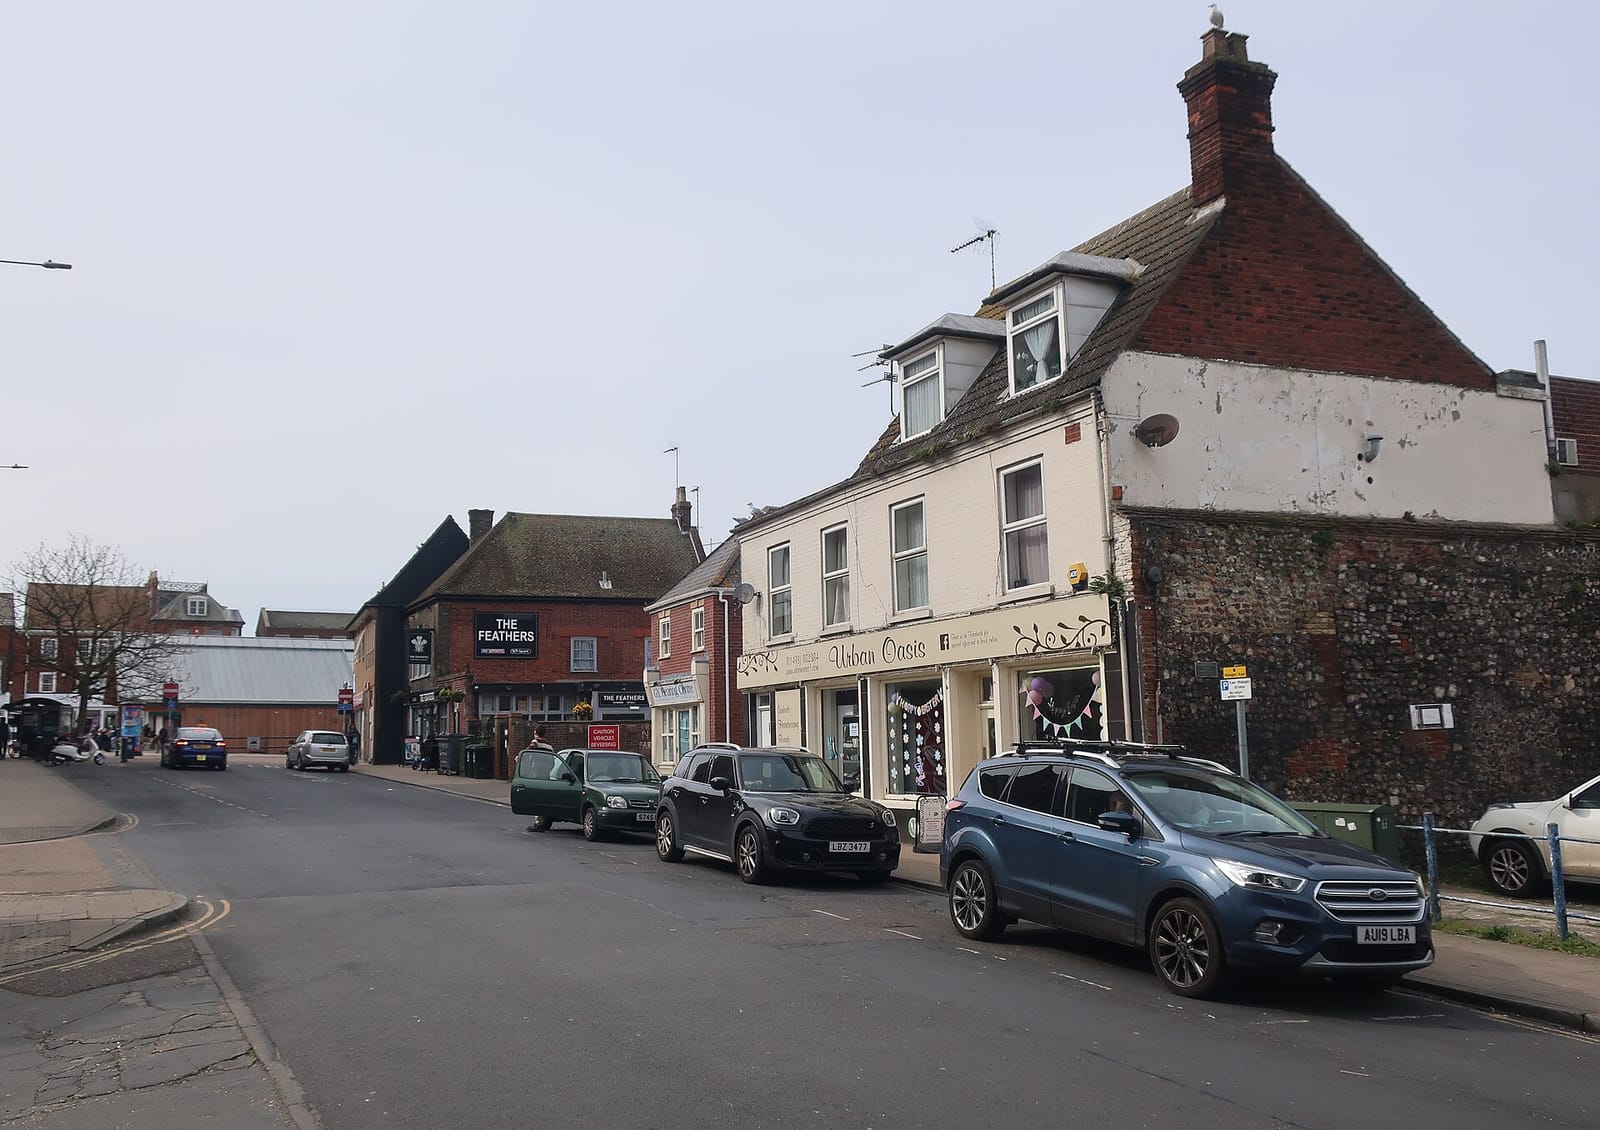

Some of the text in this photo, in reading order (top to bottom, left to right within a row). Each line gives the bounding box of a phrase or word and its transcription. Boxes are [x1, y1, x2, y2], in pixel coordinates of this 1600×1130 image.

[496, 618, 518, 630] THE
[478, 630, 535, 642] FEATHERS
[827, 644, 875, 670] Urban
[881, 635, 926, 664] Oasis
[832, 842, 867, 851] LBZ 3477
[1364, 928, 1410, 942] AU19 LBA
